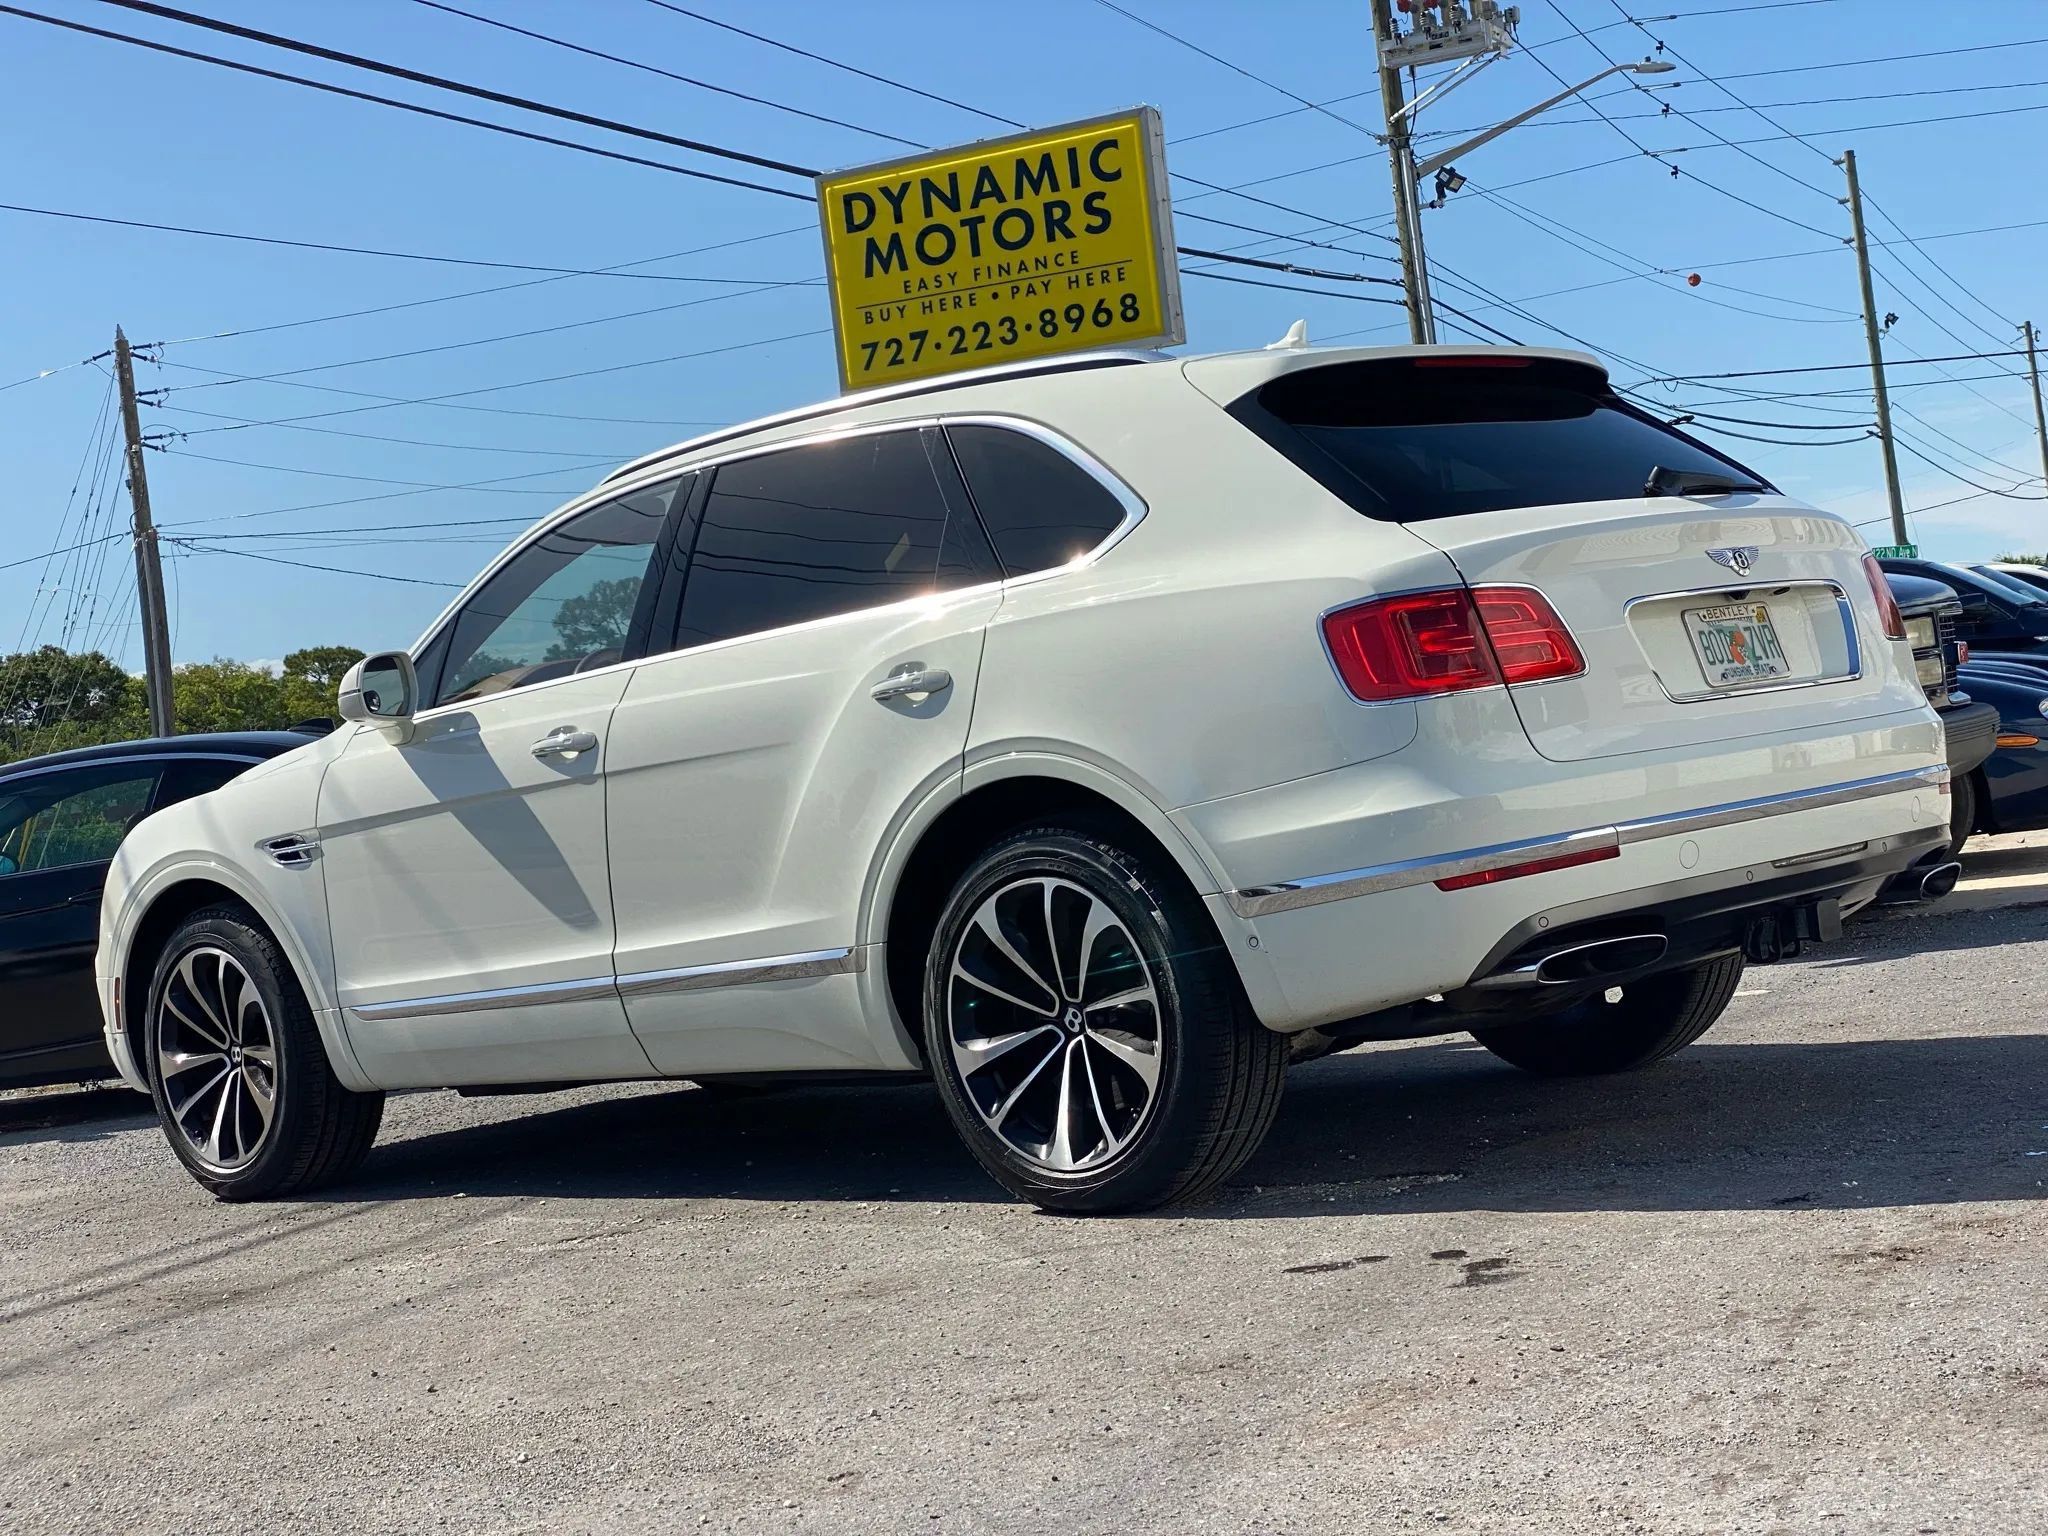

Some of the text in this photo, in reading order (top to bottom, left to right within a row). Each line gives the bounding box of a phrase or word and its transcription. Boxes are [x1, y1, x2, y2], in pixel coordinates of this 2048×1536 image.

[842, 139, 1122, 234] DYNAMIC
[864, 191, 1112, 278] MOTORS
[864, 266, 1126, 325] BUY HERE PAY HERE
[903, 250, 1080, 294] EASY FINANCE
[1706, 605, 1749, 619] BENTLEY
[1743, 624, 1781, 660] ZVR
